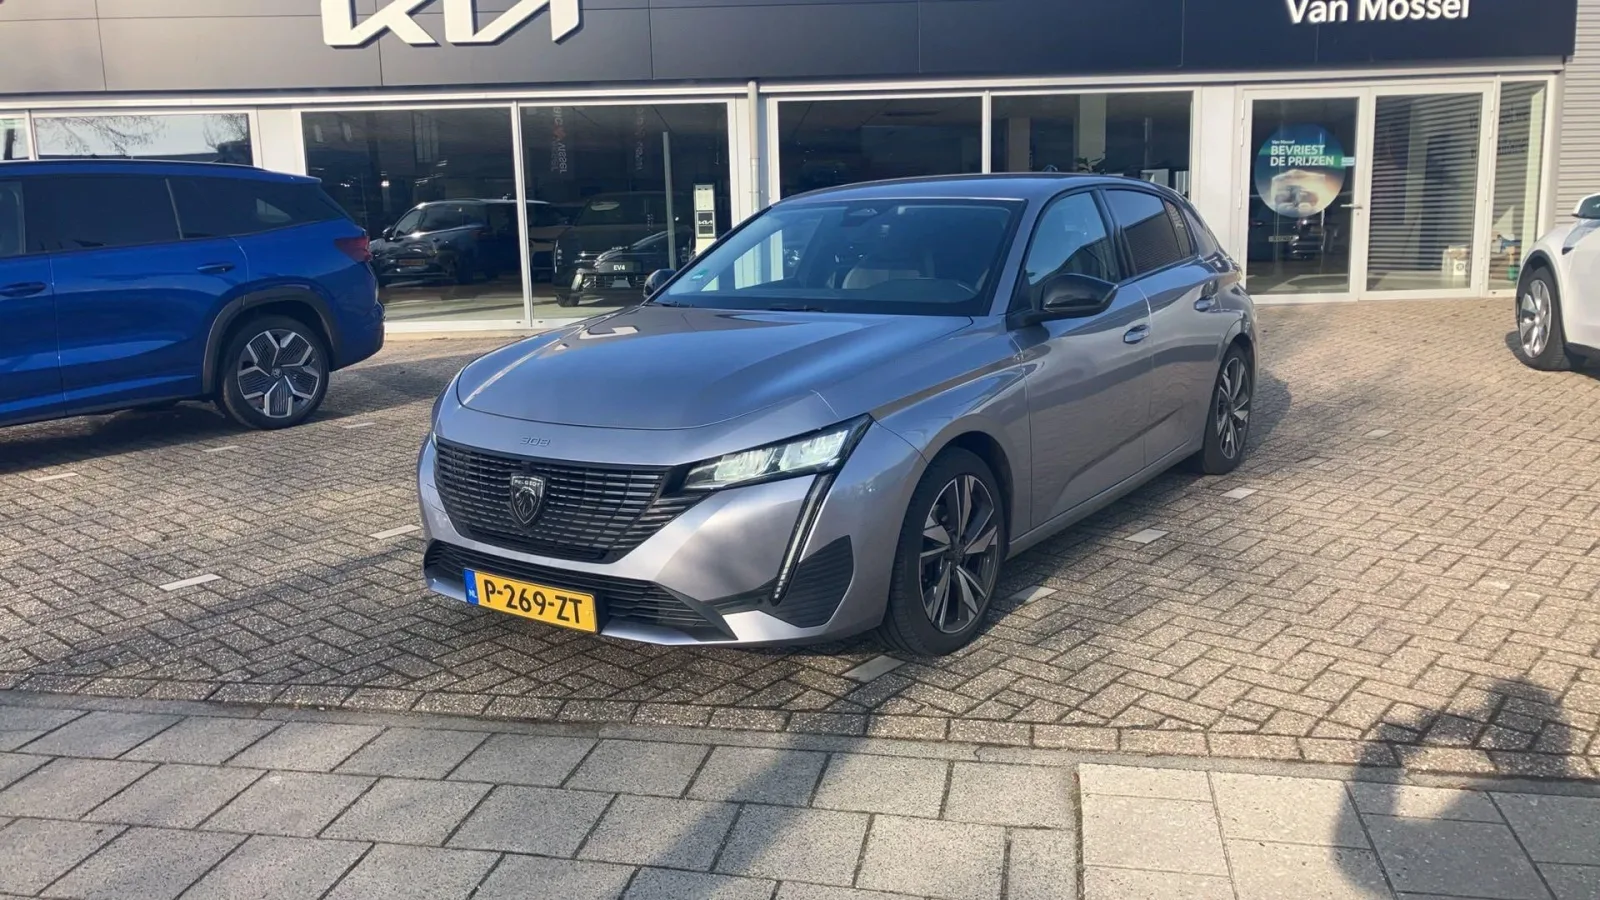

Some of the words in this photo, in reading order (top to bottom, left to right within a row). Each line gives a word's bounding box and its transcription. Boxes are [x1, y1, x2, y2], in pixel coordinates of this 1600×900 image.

[1286, 0, 1348, 24] Van
[1357, 0, 1470, 21] Mossel
[320, 0, 580, 45] KIA
[1270, 145, 1326, 156] BEVRIEST
[1270, 156, 1286, 166] DE
[1288, 156, 1335, 166] PRIJZEN
[520, 437, 551, 447] 308
[468, 589, 477, 598] NL
[483, 578, 583, 624] P-269-ZT
